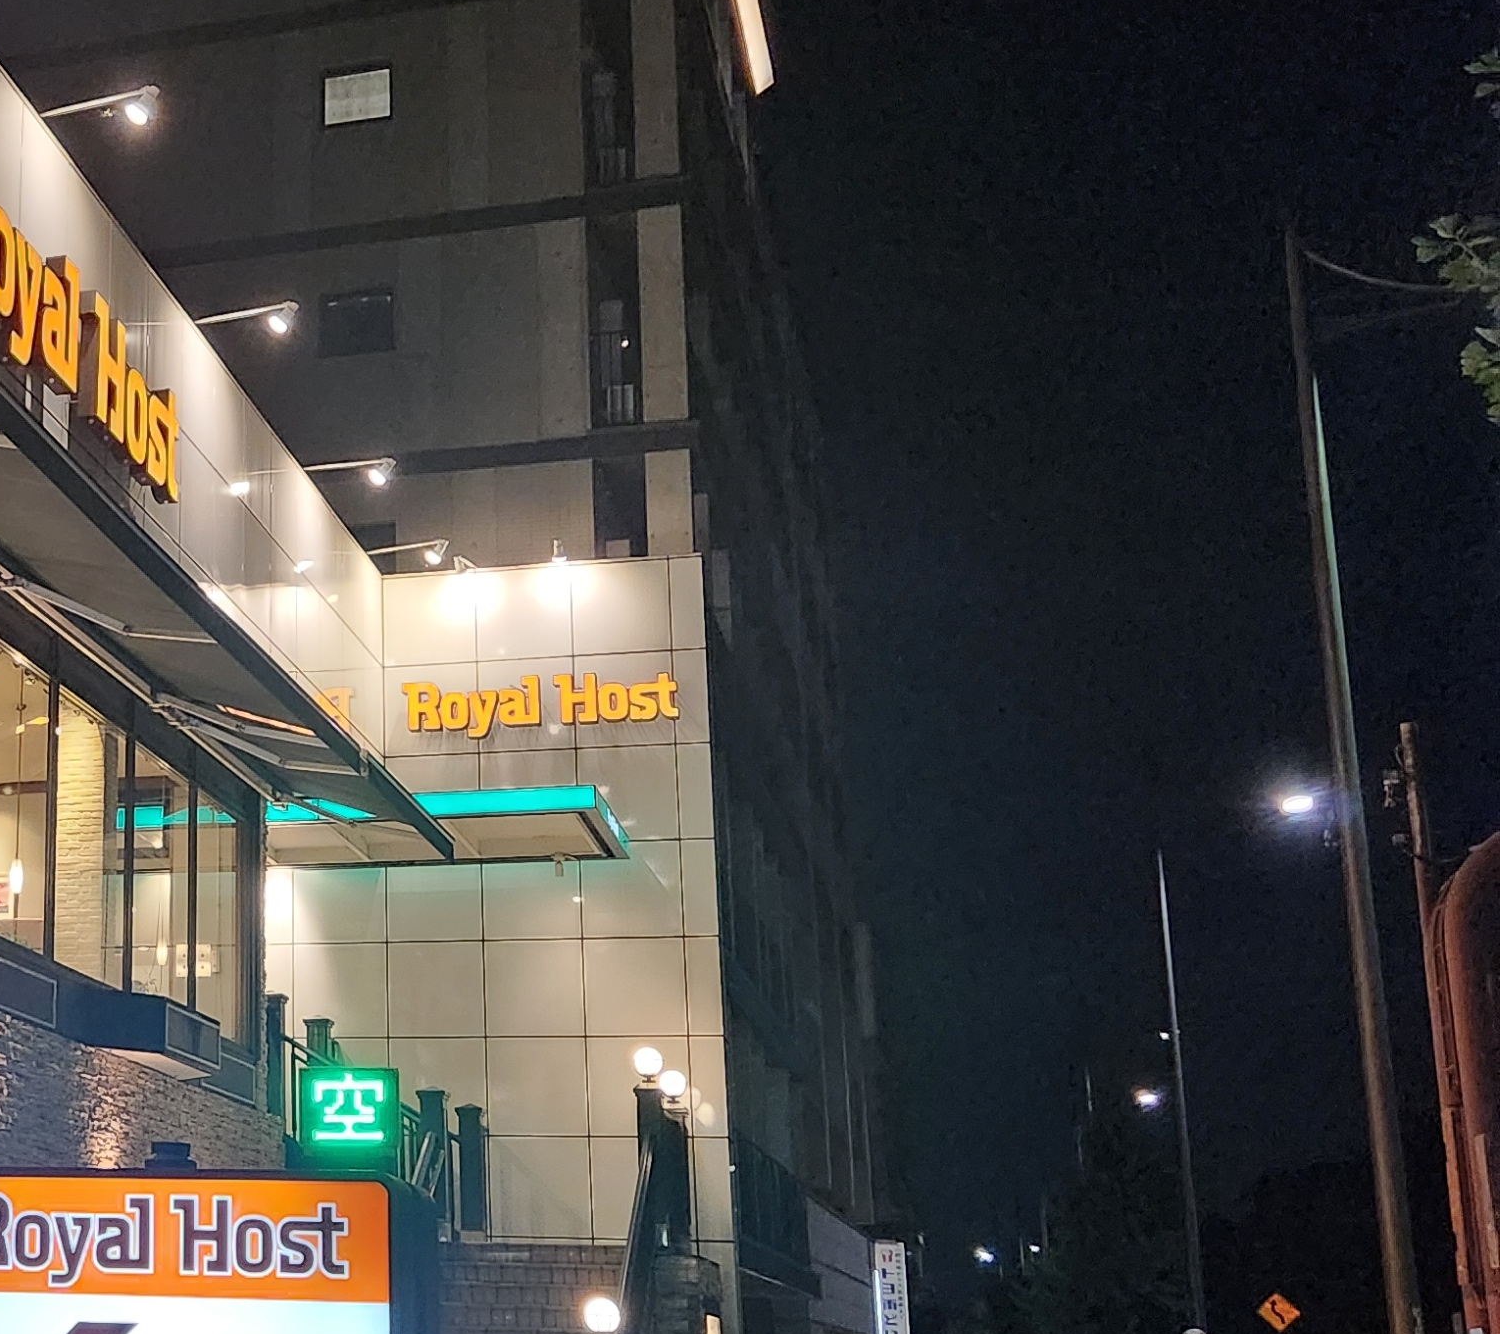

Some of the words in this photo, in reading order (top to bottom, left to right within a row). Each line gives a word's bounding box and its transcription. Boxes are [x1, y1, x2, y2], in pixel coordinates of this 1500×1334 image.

[93, 291, 179, 503] Host
[402, 674, 542, 739] Royal
[553, 672, 680, 725] Host
[310, 1072, 385, 1143] 空
[170, 1194, 350, 1280] Host
